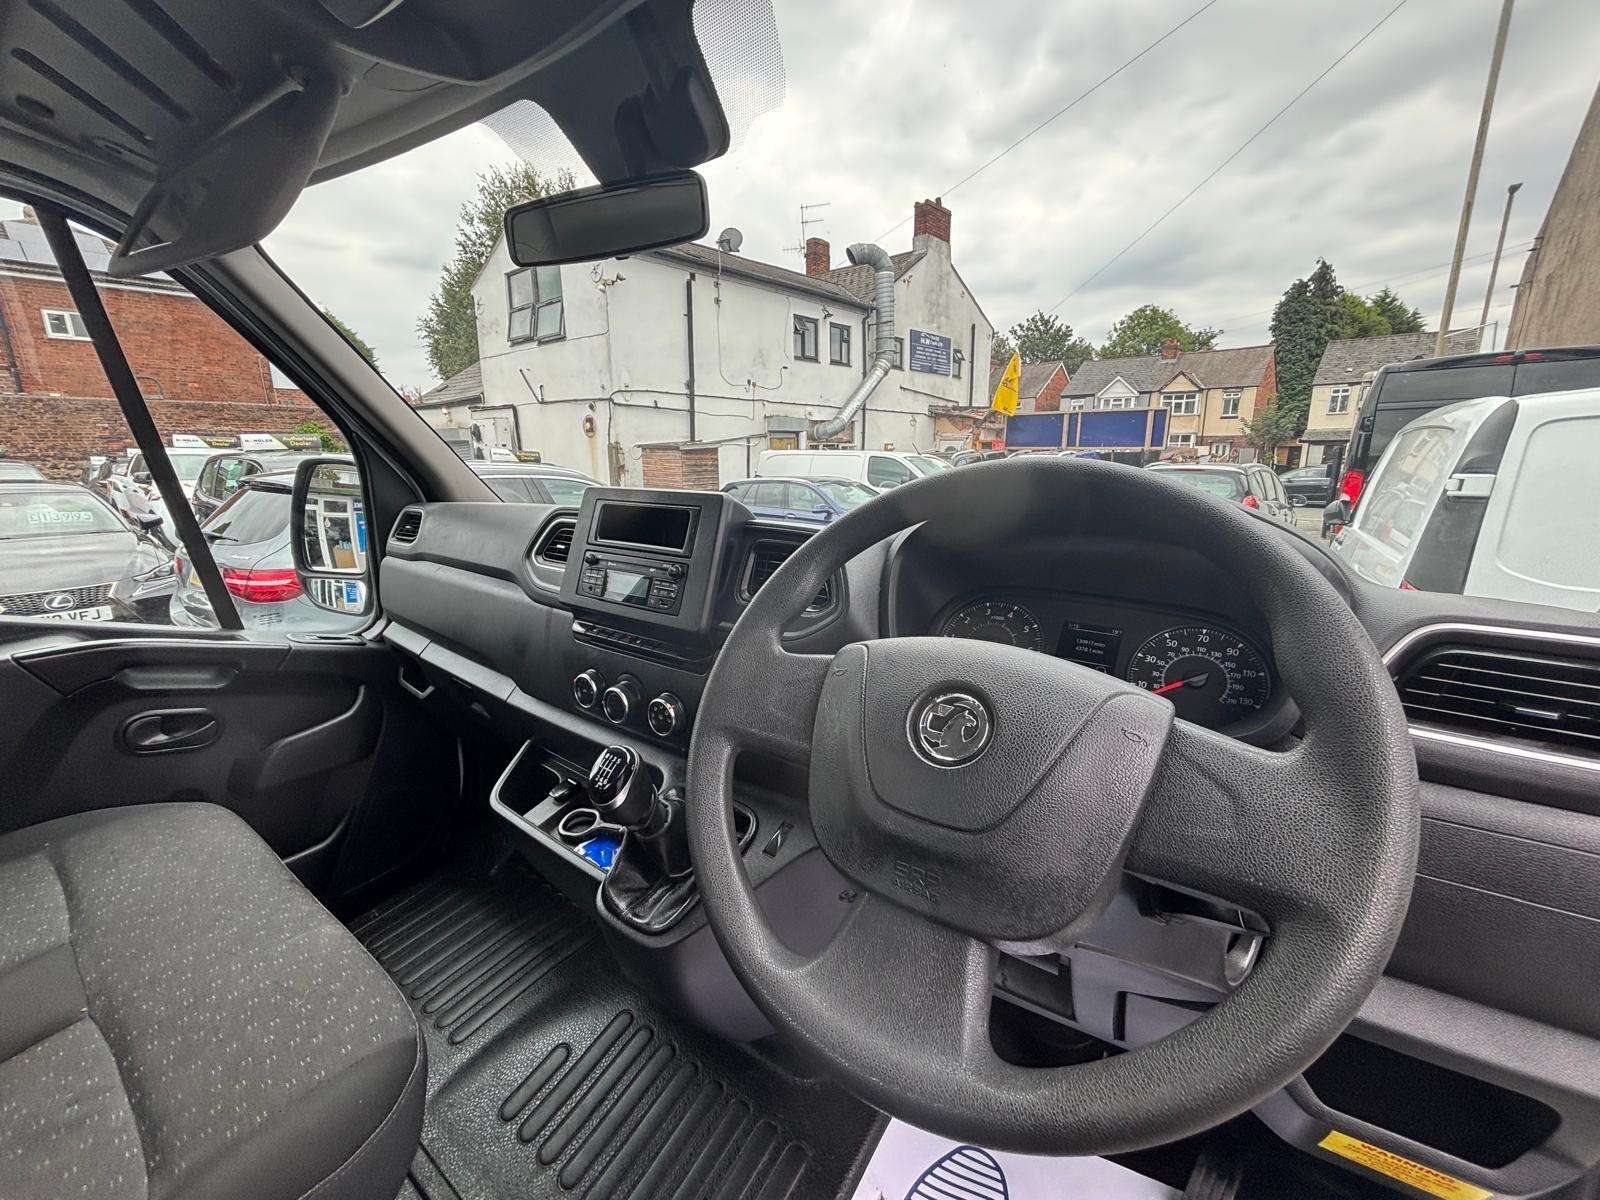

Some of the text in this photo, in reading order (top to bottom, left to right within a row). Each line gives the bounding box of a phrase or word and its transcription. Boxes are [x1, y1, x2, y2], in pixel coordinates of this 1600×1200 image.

[1198, 634, 1210, 643] 70
[1165, 639, 1178, 648] 50
[1226, 647, 1239, 656] 90
[1144, 654, 1157, 664] 30
[1242, 669, 1256, 678] 110
[1138, 680, 1147, 689] 10
[1240, 697, 1253, 706] 130
